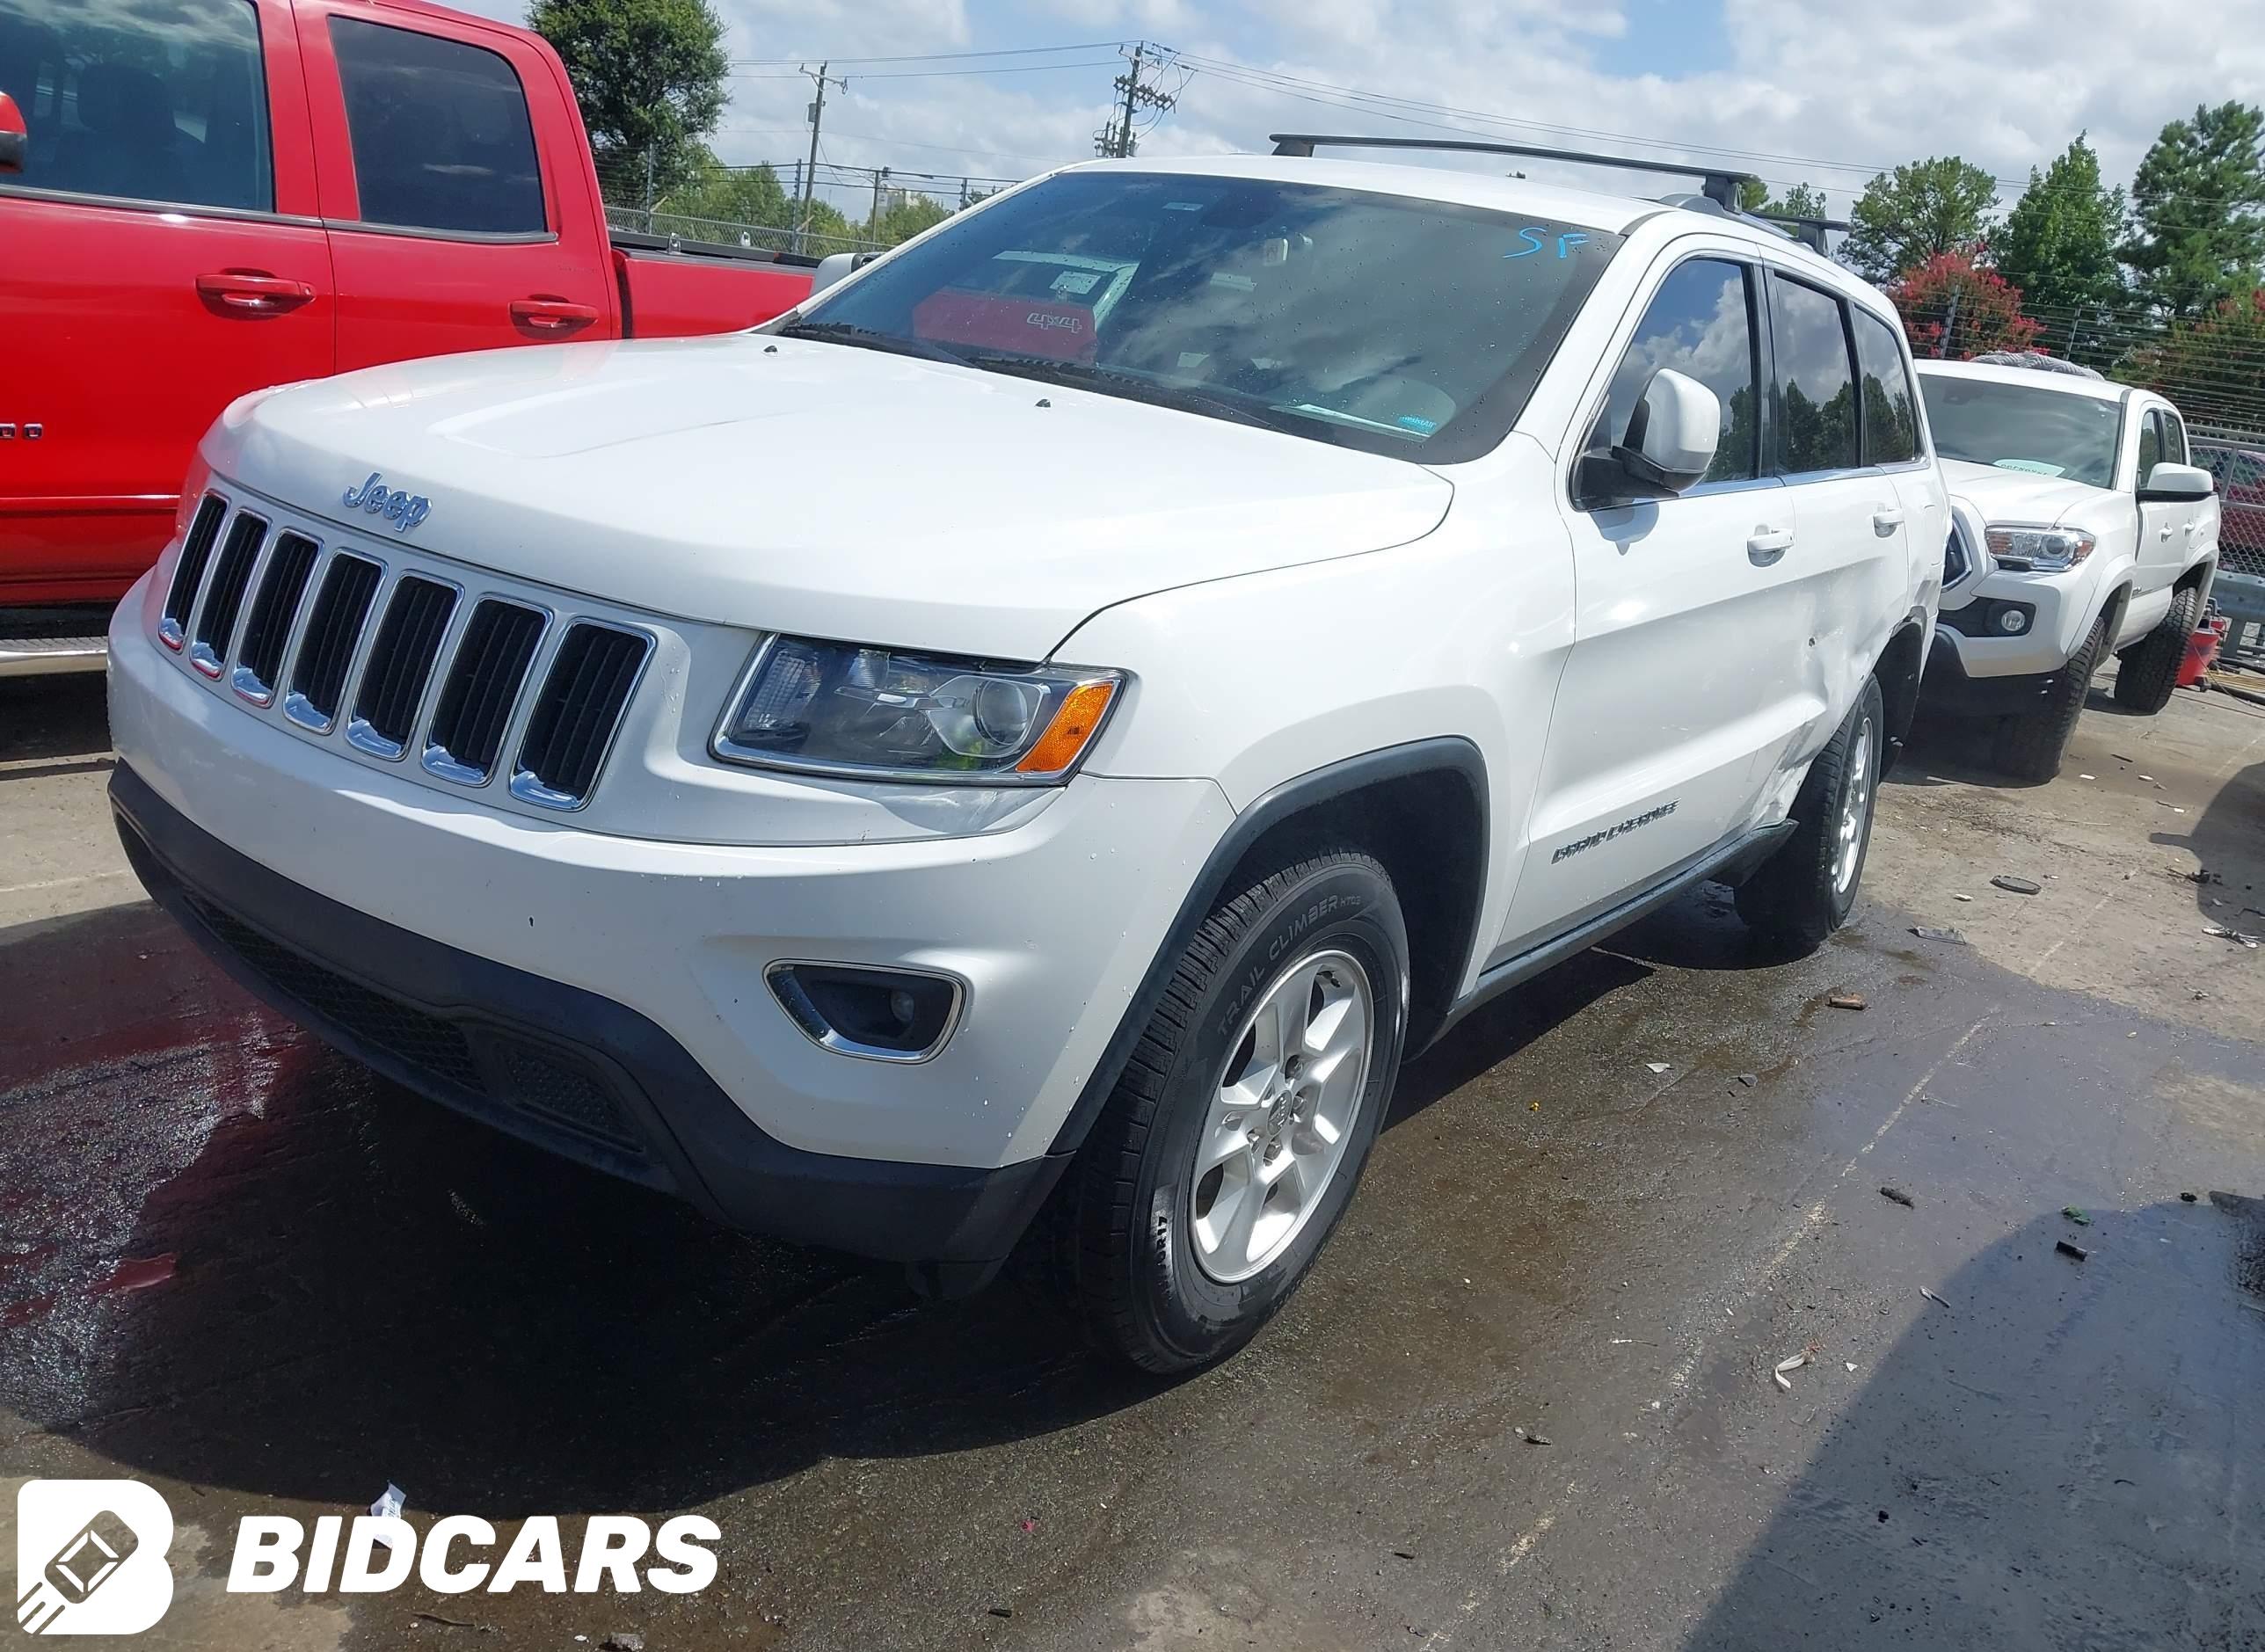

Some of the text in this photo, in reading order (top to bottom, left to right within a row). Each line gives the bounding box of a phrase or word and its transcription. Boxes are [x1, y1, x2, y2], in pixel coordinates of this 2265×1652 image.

[343, 471, 433, 533] Jeep
[1218, 967, 1265, 1035] TRAIL
[1269, 894, 1339, 961] CLIMBER
